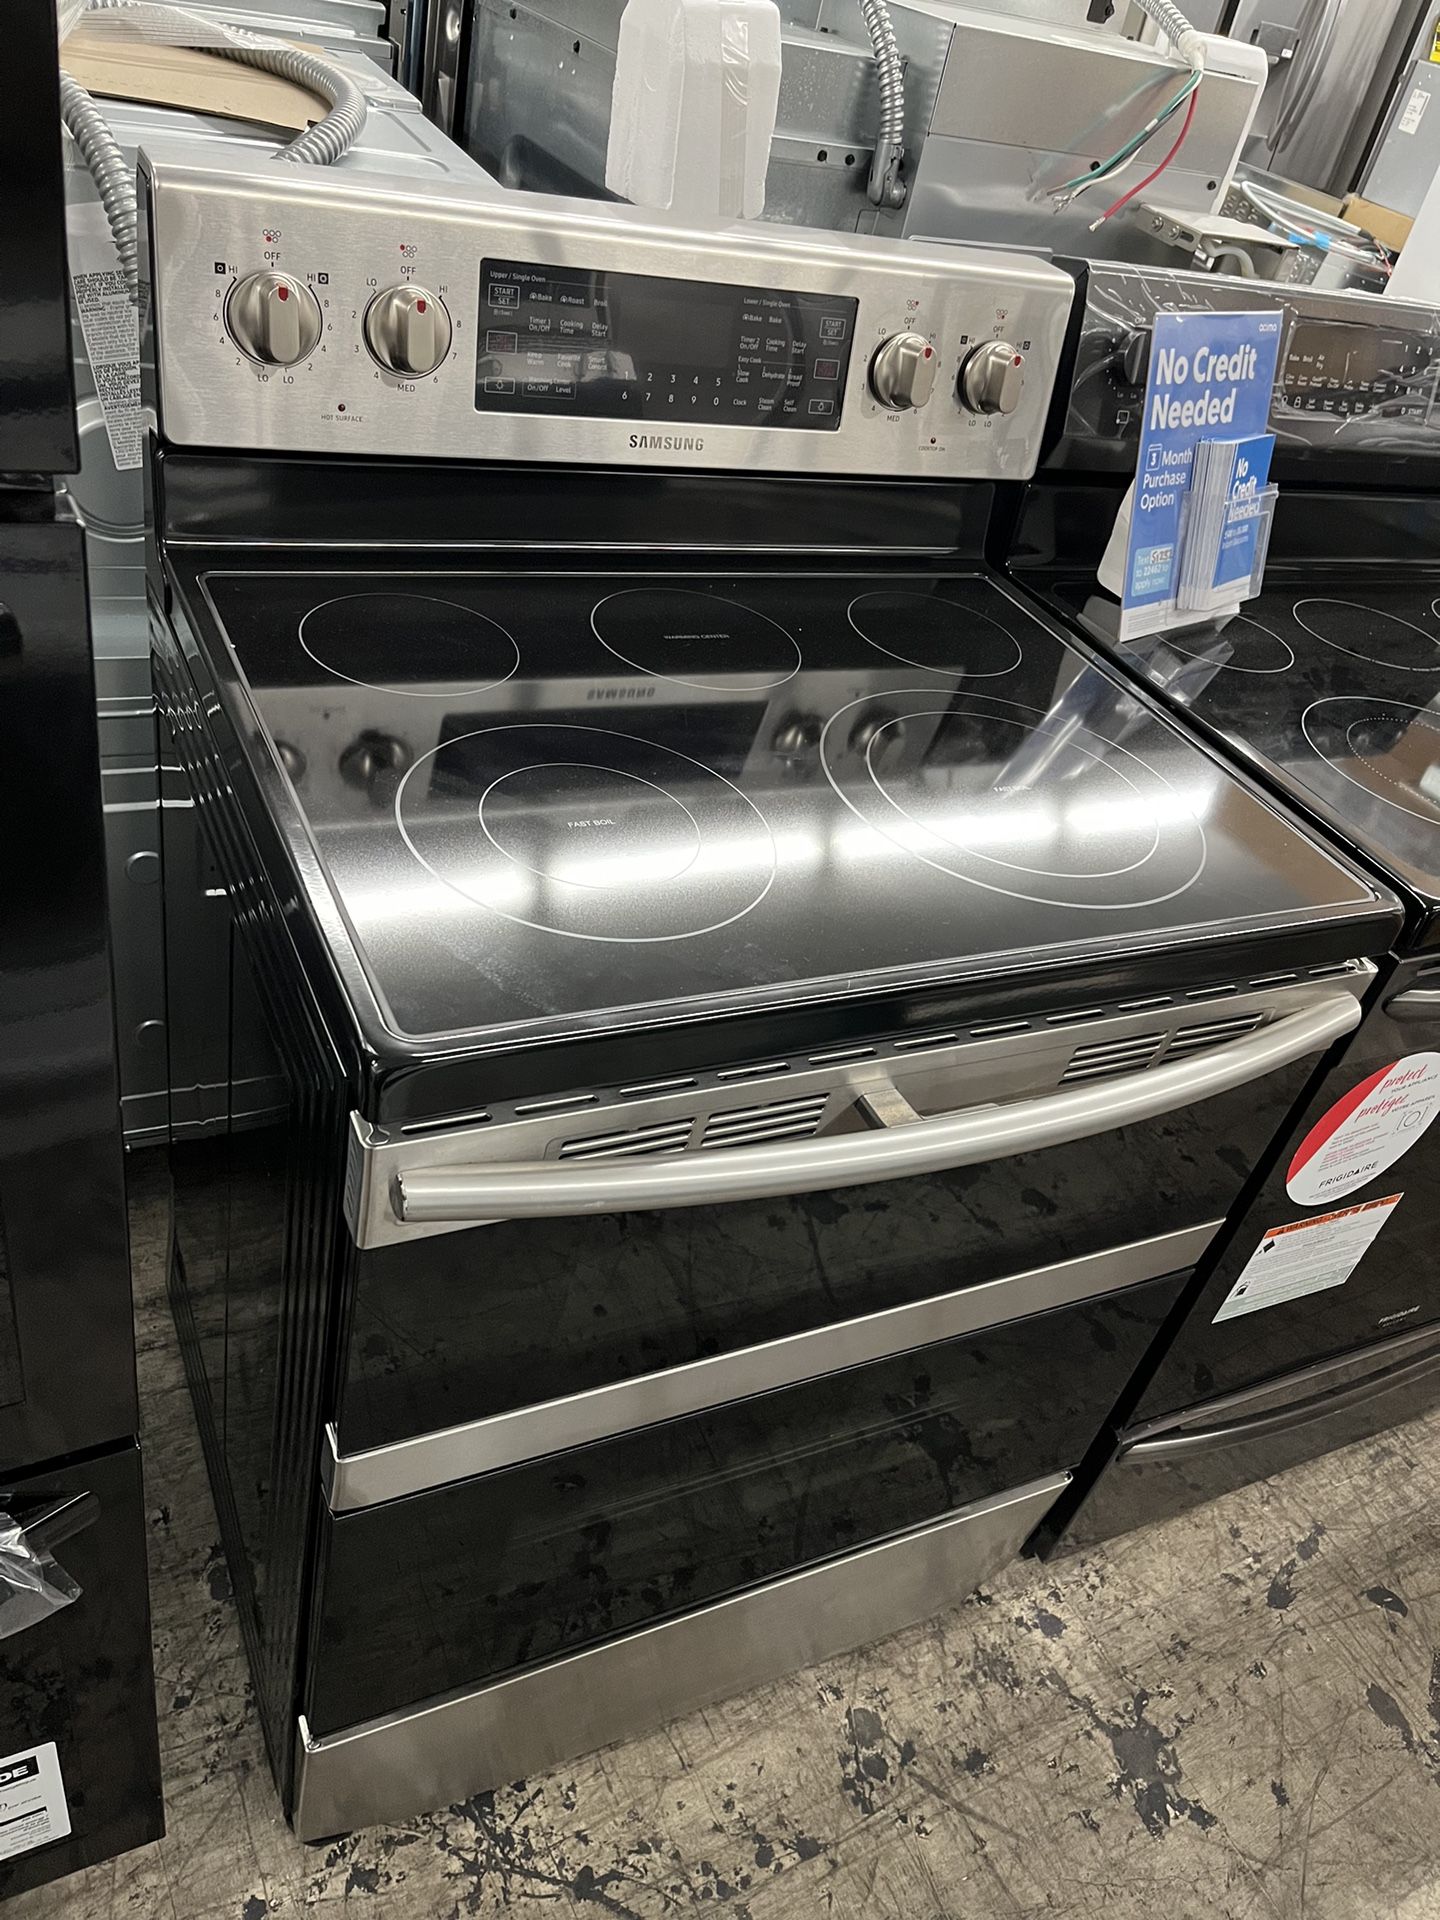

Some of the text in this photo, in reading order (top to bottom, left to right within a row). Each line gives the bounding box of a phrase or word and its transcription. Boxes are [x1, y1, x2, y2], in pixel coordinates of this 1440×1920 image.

[264, 251, 281, 261] OFF
[228, 265, 239, 274] HI
[400, 265, 417, 275] OFF
[307, 273, 317, 282] HI
[490, 270, 508, 279] Upper
[512, 272, 530, 282] Single
[531, 274, 546, 282] Oven
[366, 278, 377, 287] LO
[215, 289, 221, 298] 8
[439, 285, 448, 293] HI
[494, 287, 515, 295] START
[324, 300, 330, 308] 8
[497, 297, 510, 305] SET
[213, 312, 219, 322] 6
[351, 310, 357, 319] 2
[456, 320, 462, 329] 8
[529, 316, 547, 324] Timer
[560, 320, 584, 329] Cooking
[825, 320, 842, 328] START
[903, 317, 916, 325] OFF
[327, 323, 333, 332] 6
[529, 323, 551, 332] On/Off
[560, 327, 574, 335] Time
[878, 327, 886, 336] LO
[219, 336, 225, 345] 4
[321, 344, 327, 353] 4
[354, 345, 360, 353] 3
[452, 352, 458, 361] 7
[235, 357, 241, 366] 2
[1155, 344, 1258, 385] No Credit
[307, 363, 313, 372] 2
[257, 374, 269, 383] LO
[283, 375, 294, 385] LO
[373, 371, 380, 380] 4
[433, 375, 439, 384] 6
[625, 370, 721, 386] 1 2 3 4 5
[397, 383, 416, 393] MED
[527, 384, 549, 392] On/Off
[555, 386, 571, 394] Level
[621, 391, 719, 406] 6 7 8 9 0
[733, 398, 747, 406] Clock
[1150, 387, 1237, 431] Needed
[886, 415, 900, 423] MED
[984, 420, 992, 428] LO
[629, 434, 704, 451] SAMSUNG
[1150, 447, 1193, 467] 3 Month
[1235, 457, 1249, 479] No
[1142, 470, 1187, 490] Purchase
[1232, 475, 1257, 500] Credit
[1140, 491, 1175, 513] Option
[567, 820, 591, 828] FAST
[1379, 1064, 1428, 1095] protect
[1319, 1160, 1379, 1189] FRIGIDAIRE
